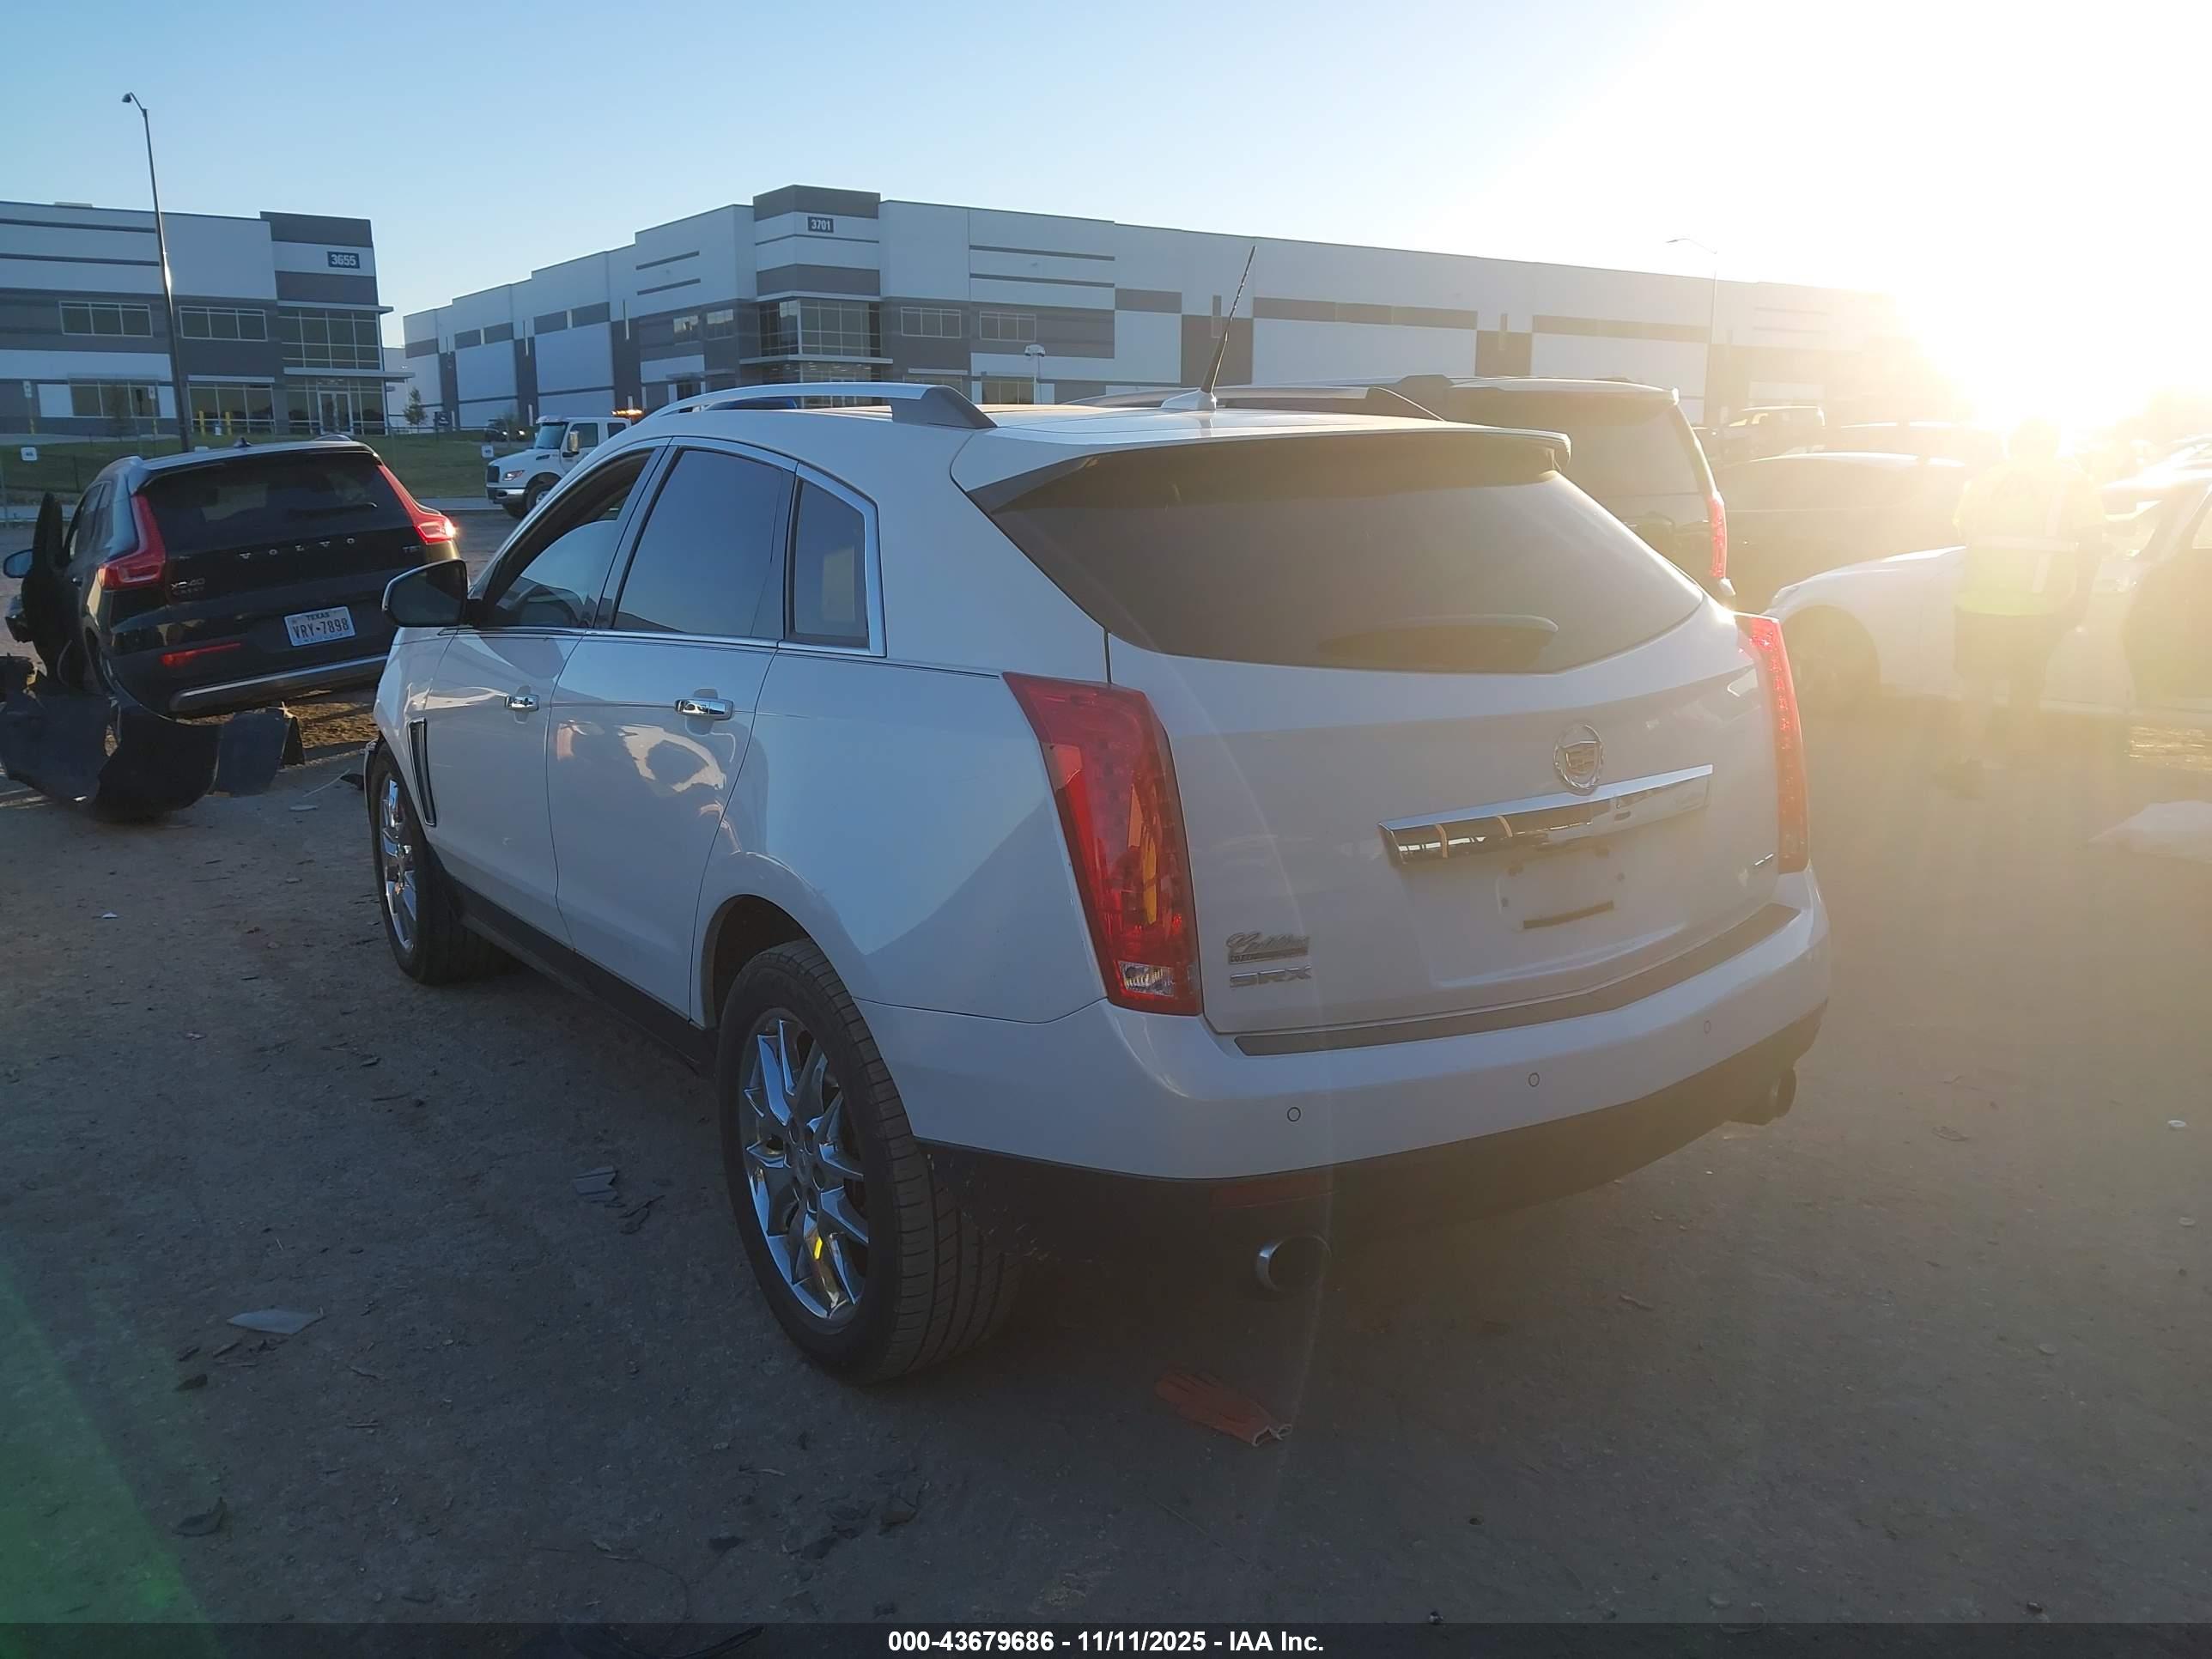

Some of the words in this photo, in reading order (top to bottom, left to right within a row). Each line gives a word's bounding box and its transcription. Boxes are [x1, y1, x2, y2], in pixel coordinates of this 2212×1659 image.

[811, 219, 830, 231] 3701
[331, 253, 356, 266] 3655
[240, 537, 356, 559] VOLVO
[306, 611, 331, 621] TEXAS
